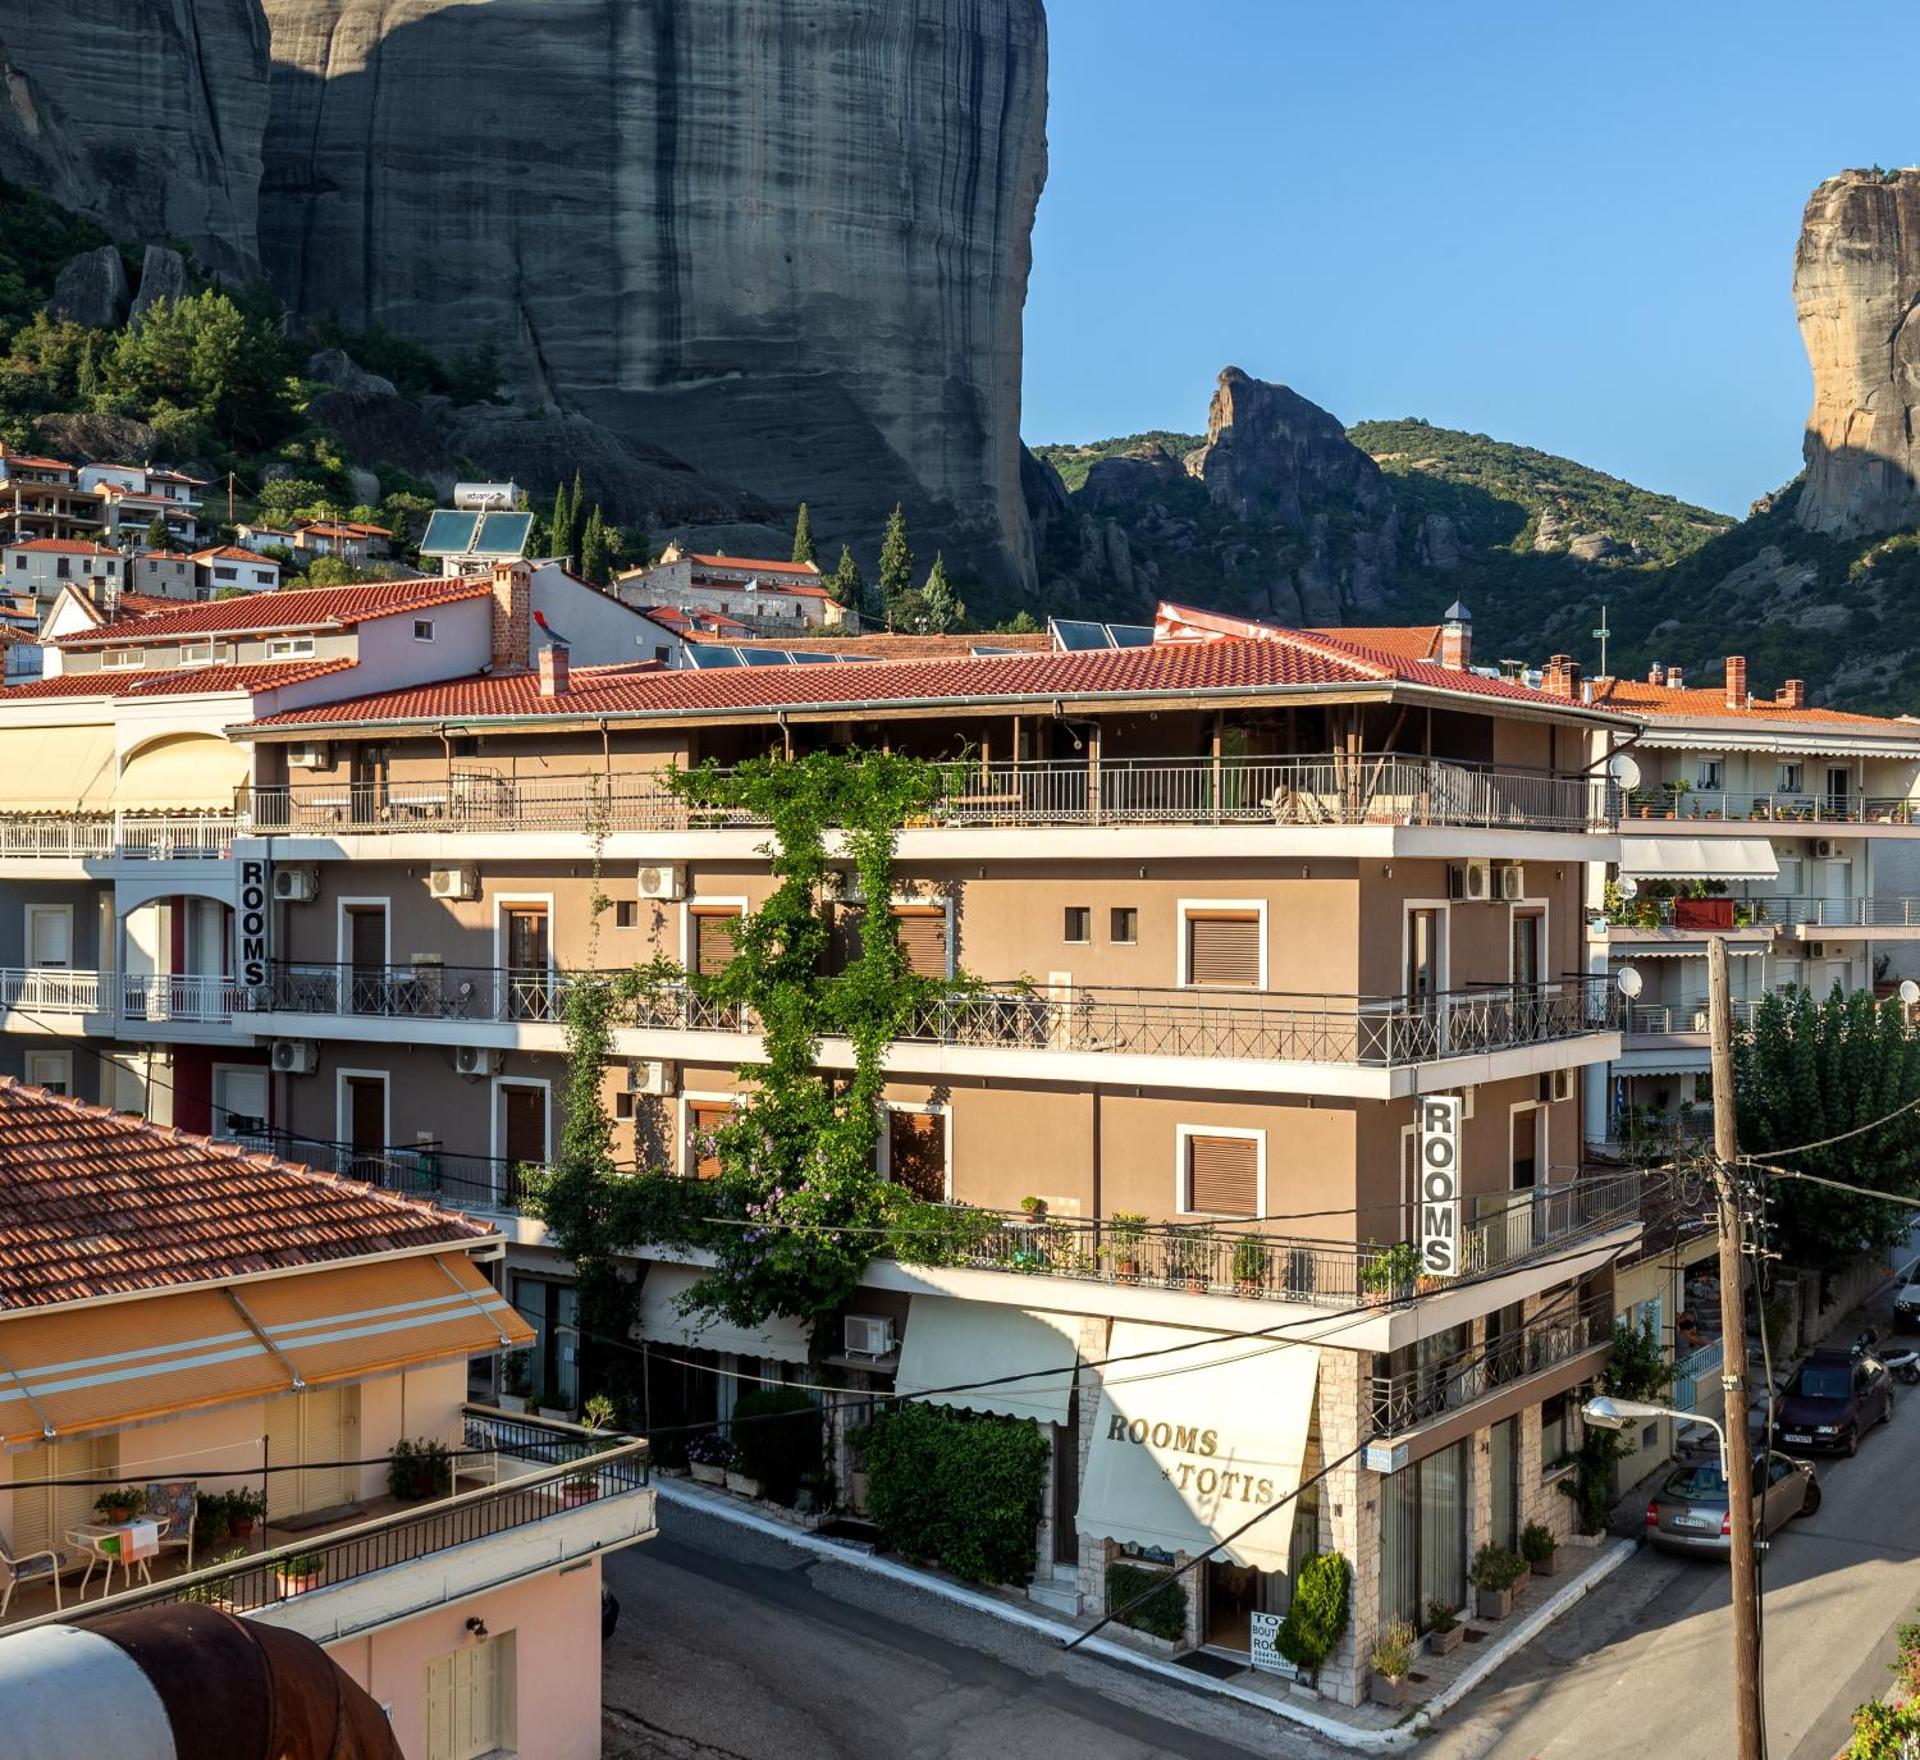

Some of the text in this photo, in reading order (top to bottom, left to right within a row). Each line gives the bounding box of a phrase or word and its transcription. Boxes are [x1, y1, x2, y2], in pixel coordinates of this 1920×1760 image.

[242, 862, 264, 986] ROOMS
[1425, 1102, 1453, 1272] ROOMS
[1107, 1414, 1218, 1457] ROOMS
[1177, 1462, 1274, 1510] TOTIS
[1252, 1625, 1278, 1638] BOUT
[1253, 1613, 1284, 1626] TO
[1254, 1638, 1277, 1651] ROO
